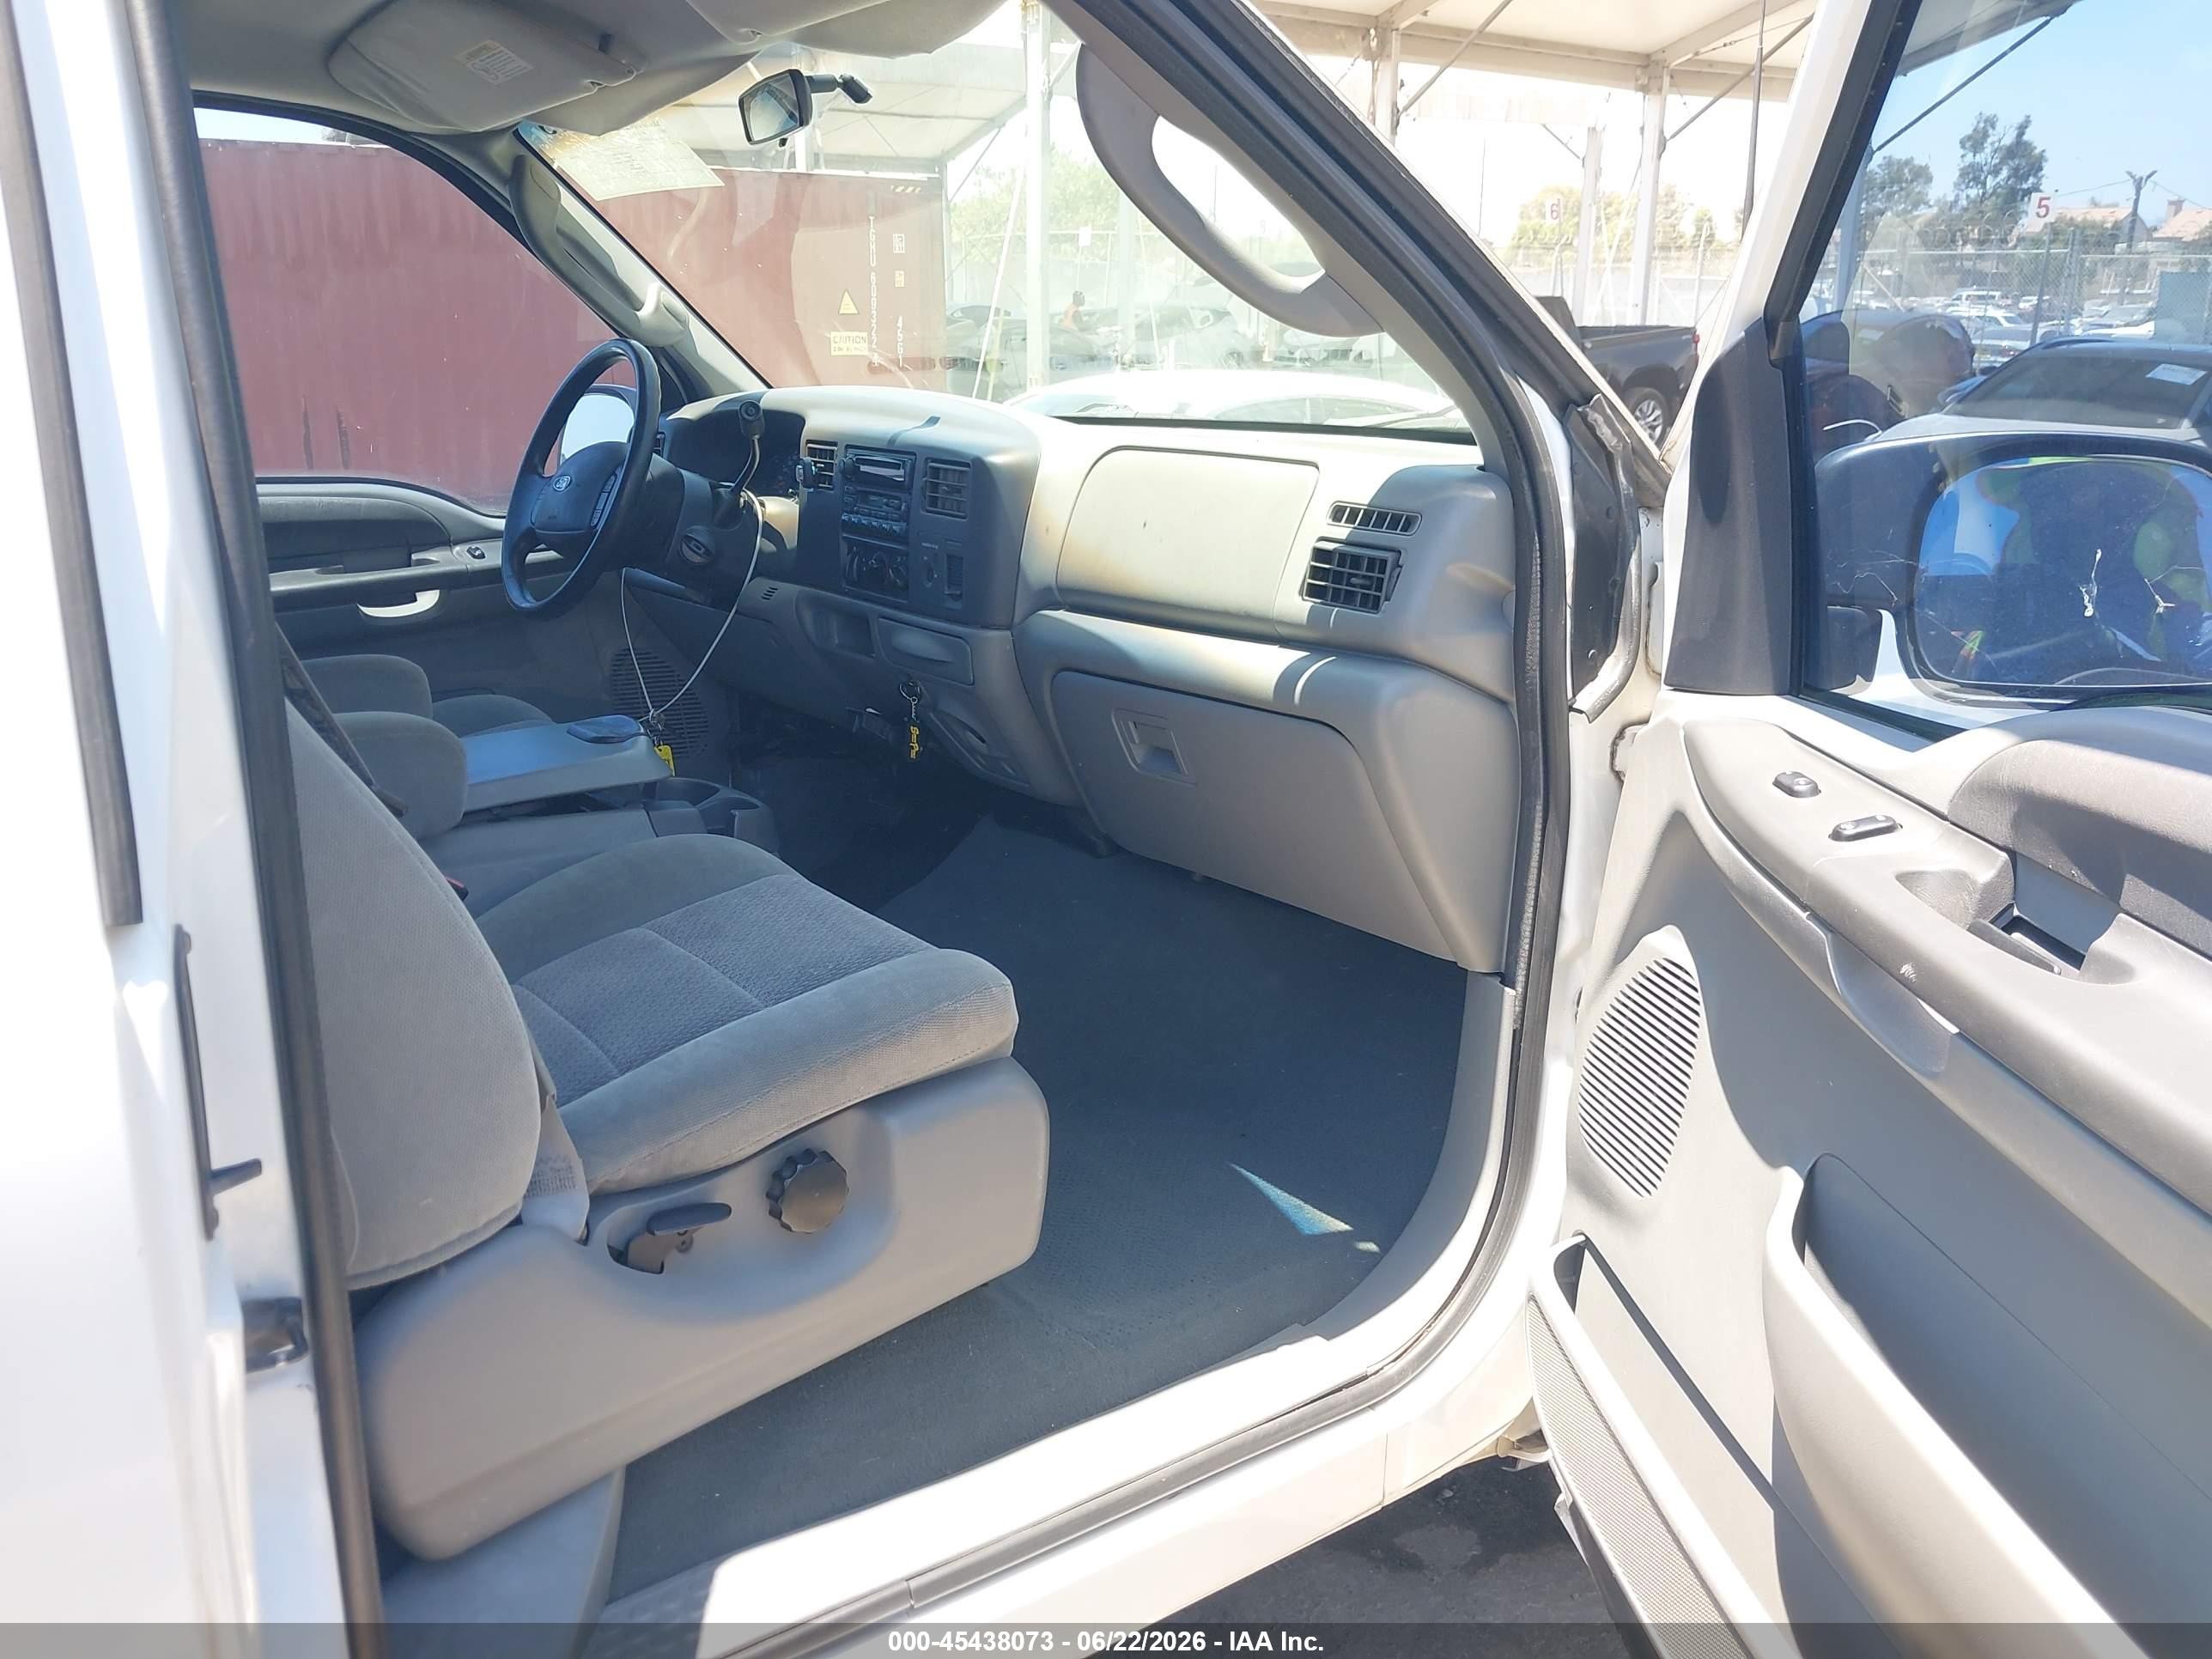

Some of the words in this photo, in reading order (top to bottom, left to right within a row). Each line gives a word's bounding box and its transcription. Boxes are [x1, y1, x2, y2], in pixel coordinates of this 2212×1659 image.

[1550, 203, 1559, 220] 6
[2035, 196, 2051, 219] 5
[832, 335, 866, 344] CAUTION
